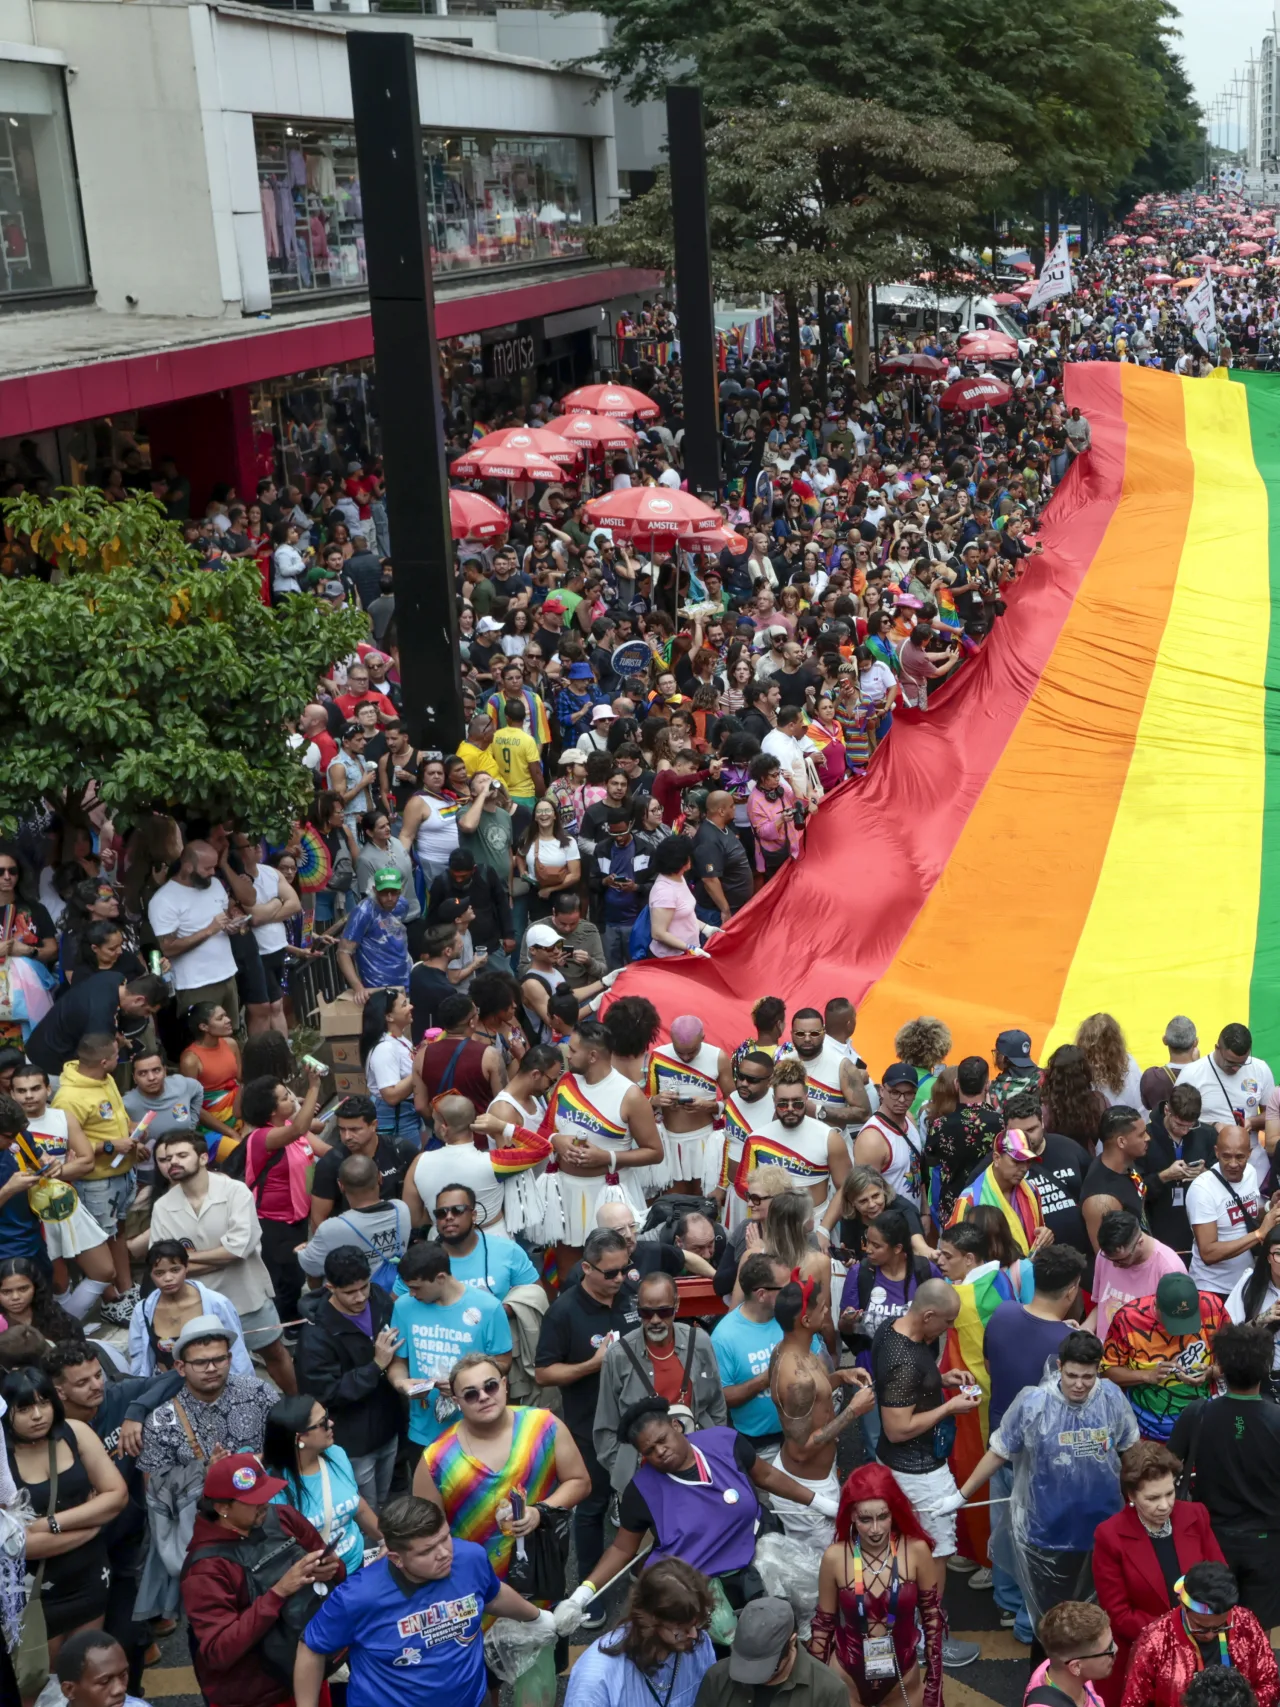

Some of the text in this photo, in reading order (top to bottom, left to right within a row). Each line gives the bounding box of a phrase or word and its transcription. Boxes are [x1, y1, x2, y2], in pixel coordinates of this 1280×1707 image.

[963, 385, 1000, 400] BRAHMA
[488, 466, 515, 475] AMSTEL
[599, 517, 626, 528] AMSTEL
[647, 521, 680, 531] AMSTEL
[618, 657, 641, 668] TURISTA
[495, 736, 521, 747] RONALDO
[502, 747, 511, 773] 9
[411, 1324, 473, 1343] POLÍTICA&
[413, 1338, 461, 1355] GARRA&
[400, 1594, 478, 1635] ENVELHECER
